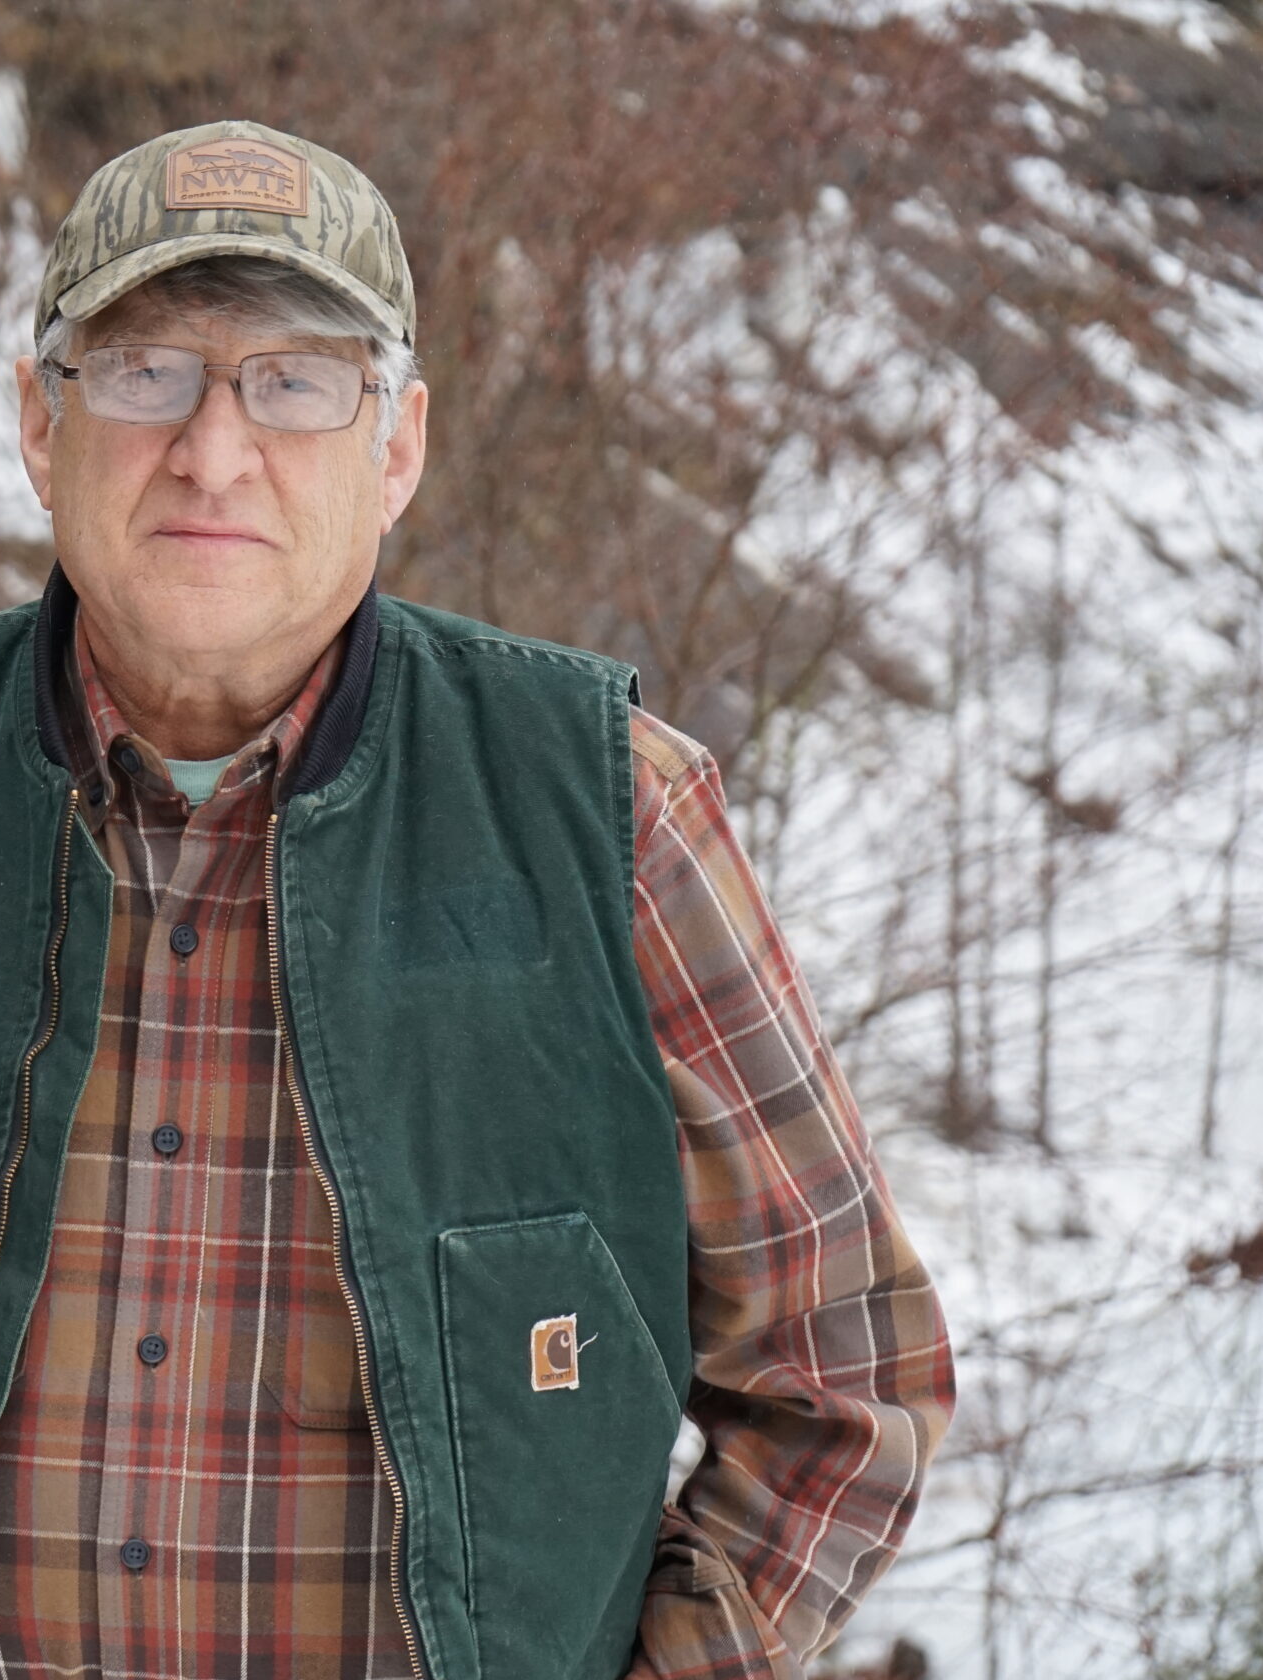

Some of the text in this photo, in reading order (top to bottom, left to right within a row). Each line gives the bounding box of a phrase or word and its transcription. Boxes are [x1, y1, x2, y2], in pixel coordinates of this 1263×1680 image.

[181, 169, 294, 196] NWTF
[181, 189, 295, 206] Conserve. Hunt. Share.
